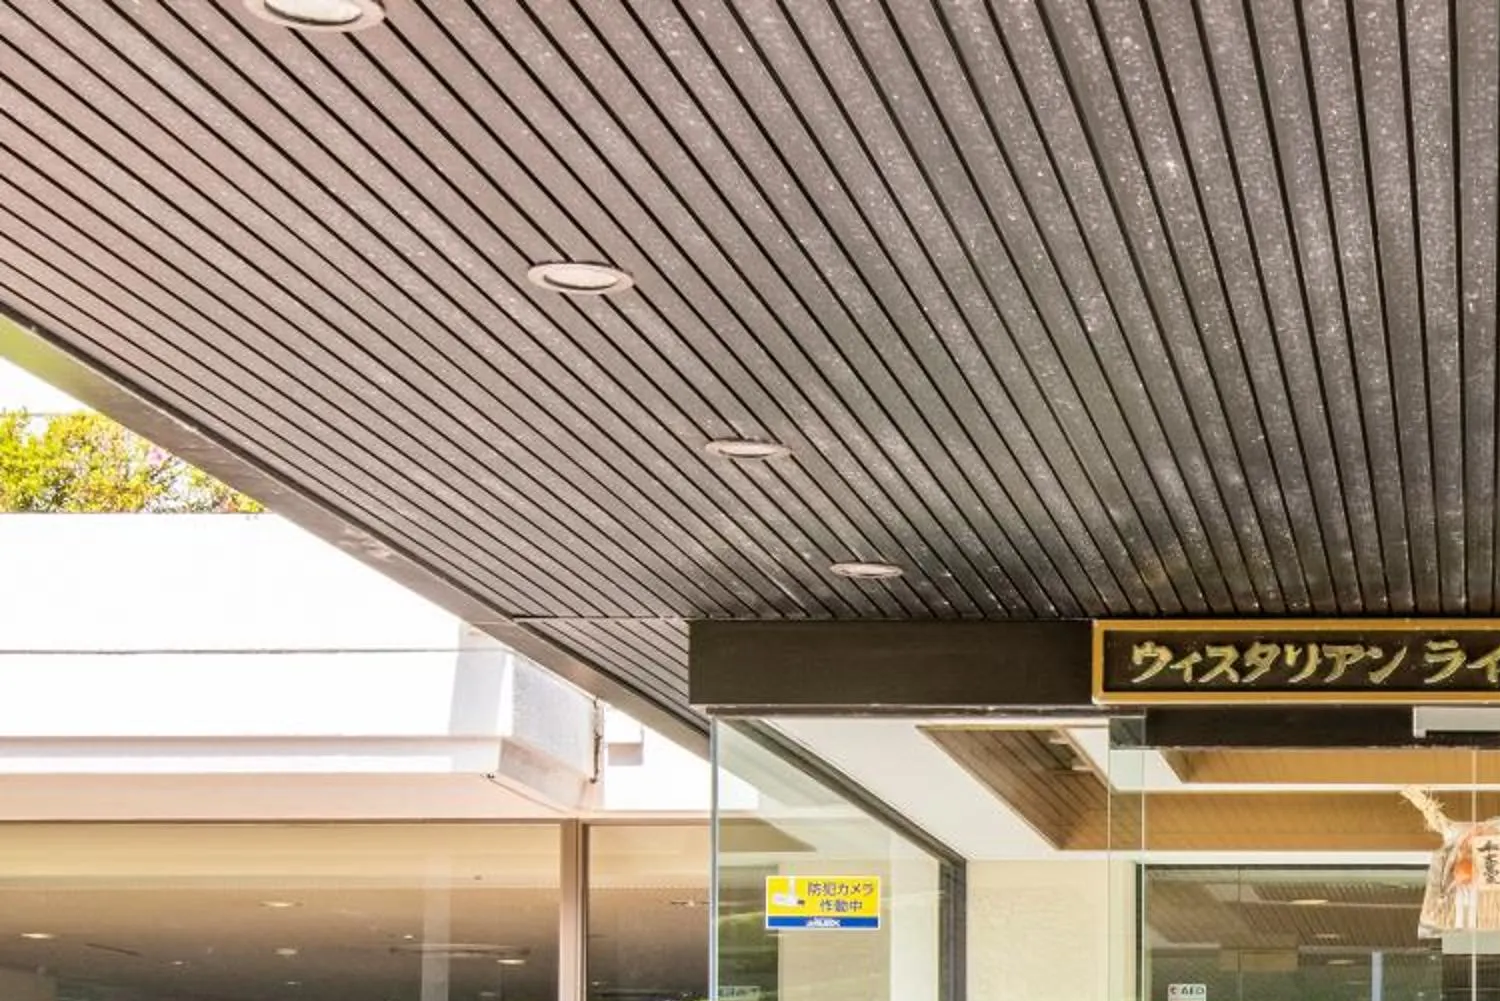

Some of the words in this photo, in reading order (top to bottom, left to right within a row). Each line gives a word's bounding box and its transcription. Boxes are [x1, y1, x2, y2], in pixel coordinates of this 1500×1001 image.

[1130, 640, 1408, 685] ウィスタリアン
[807, 881, 875, 897] 防犯カメラ
[819, 898, 863, 912] 作動中
